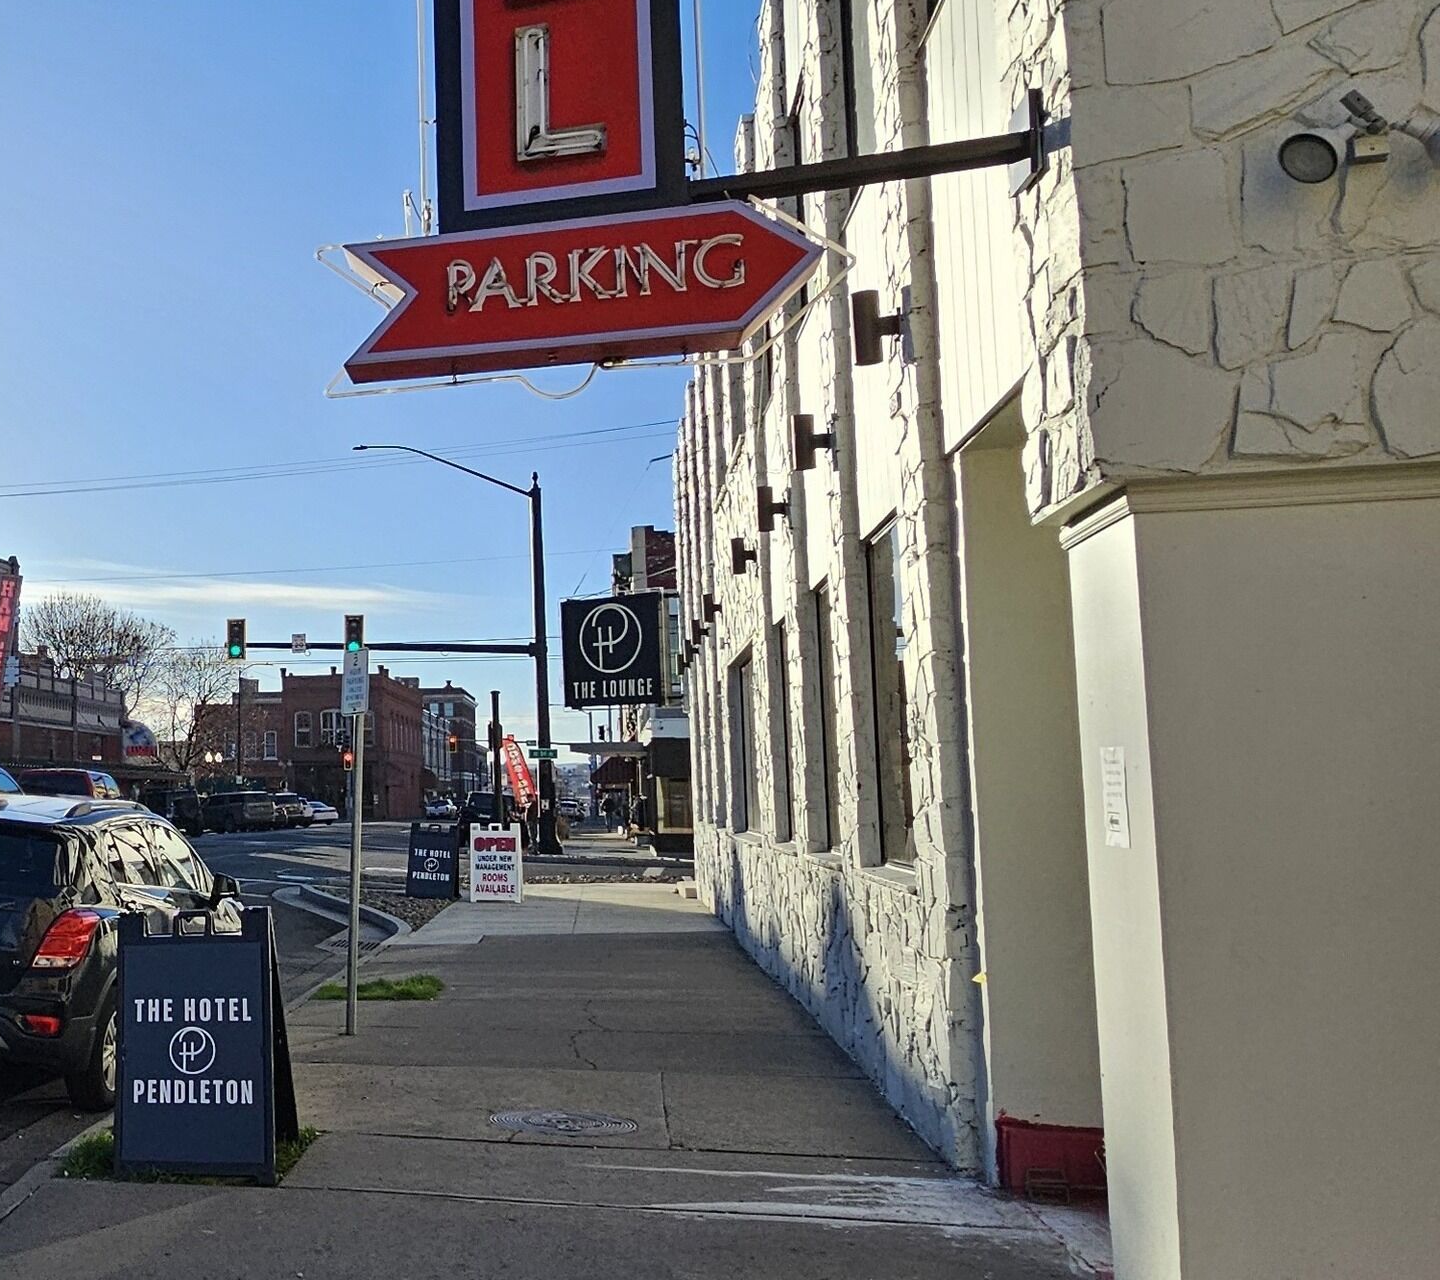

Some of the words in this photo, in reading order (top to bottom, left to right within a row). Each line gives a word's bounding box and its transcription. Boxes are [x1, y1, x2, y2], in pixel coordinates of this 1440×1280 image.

[446, 233, 746, 316] PARKING
[573, 681, 596, 699] THE
[603, 678, 653, 698] LOUNGE
[474, 837, 516, 852] OPEN
[414, 848, 427, 857] THE
[430, 849, 451, 859] HOTEL
[475, 863, 515, 871] MANAGEMENT
[412, 871, 450, 882] PENDLETON
[482, 873, 508, 882] ROOMS
[475, 884, 515, 894] AVAILABLE
[134, 998, 173, 1022] THE
[184, 997, 252, 1022] HOTEL
[133, 1079, 253, 1105] PENDLETON
